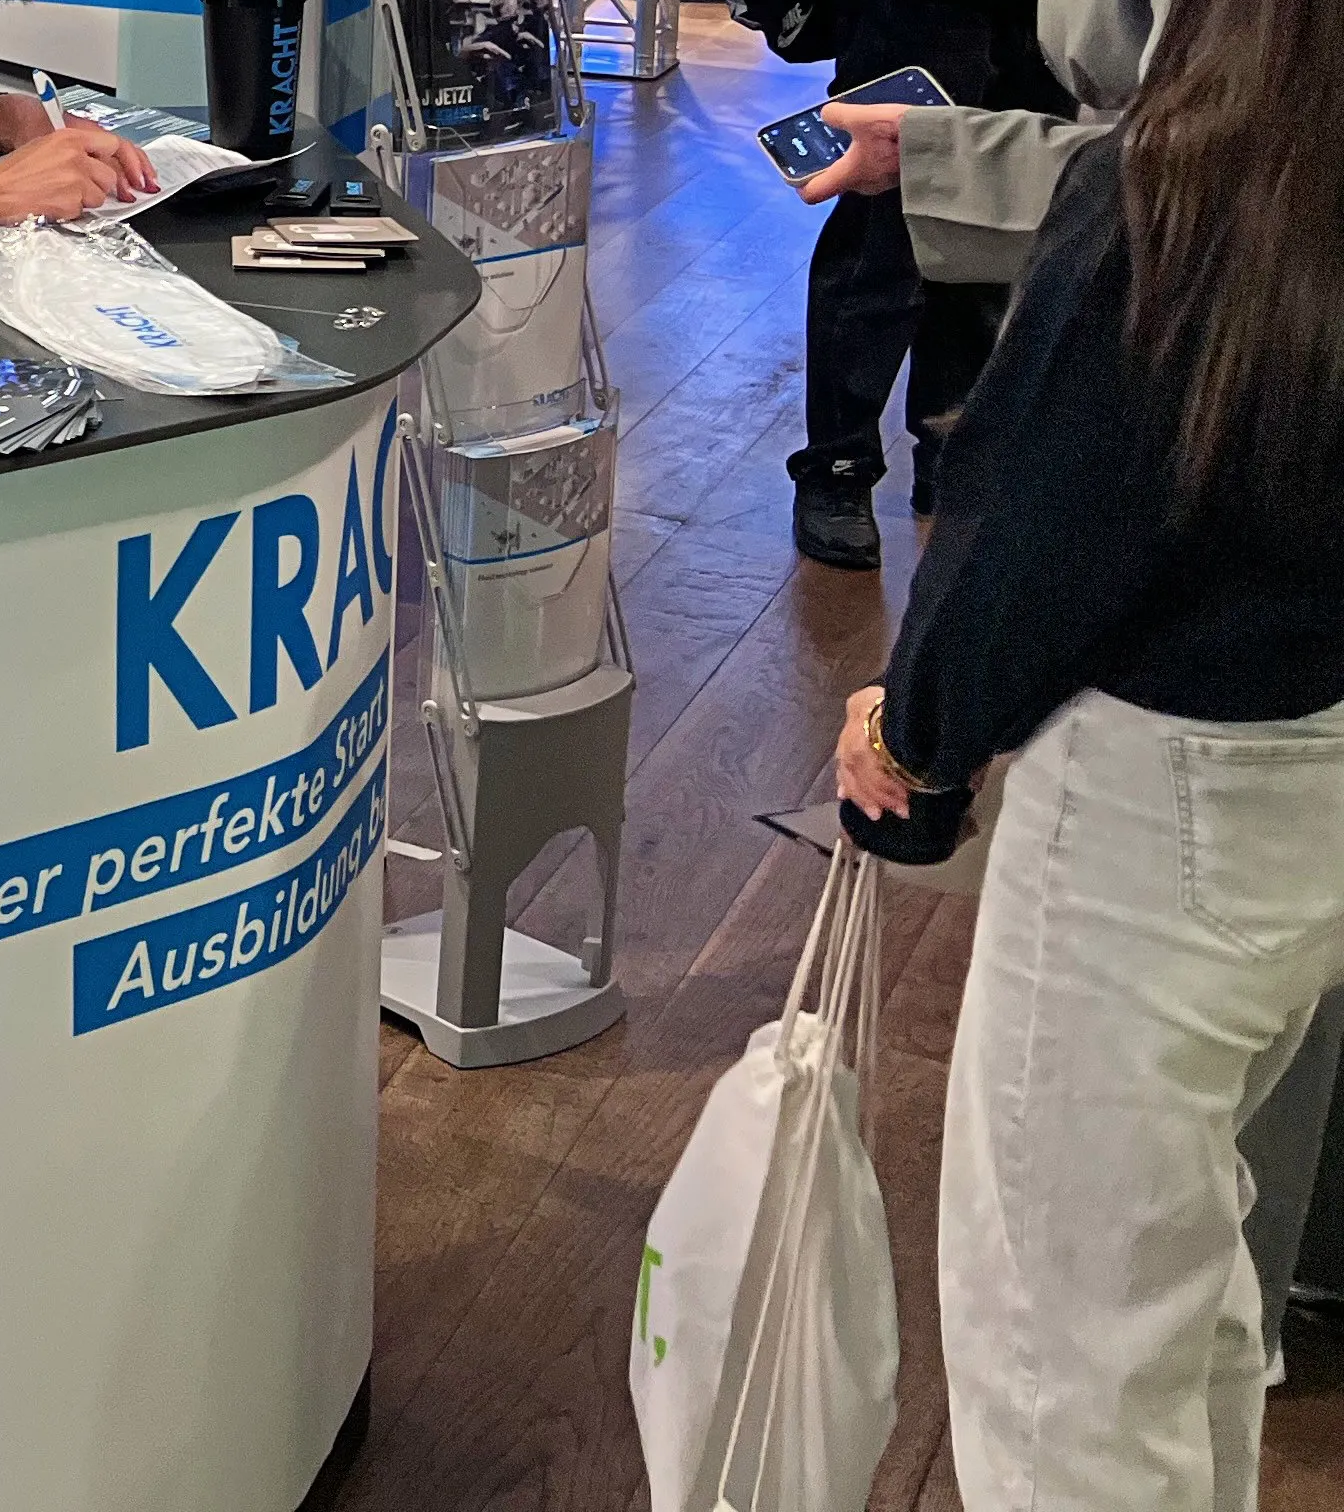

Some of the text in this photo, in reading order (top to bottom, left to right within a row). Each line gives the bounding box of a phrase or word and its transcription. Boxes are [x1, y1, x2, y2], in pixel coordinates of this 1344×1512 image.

[269, 23, 298, 136] KRACHT
[435, 85, 473, 107] JETZT
[80, 763, 326, 917] perfekte
[333, 675, 385, 788] Start
[106, 821, 363, 1012] Ausbildung
